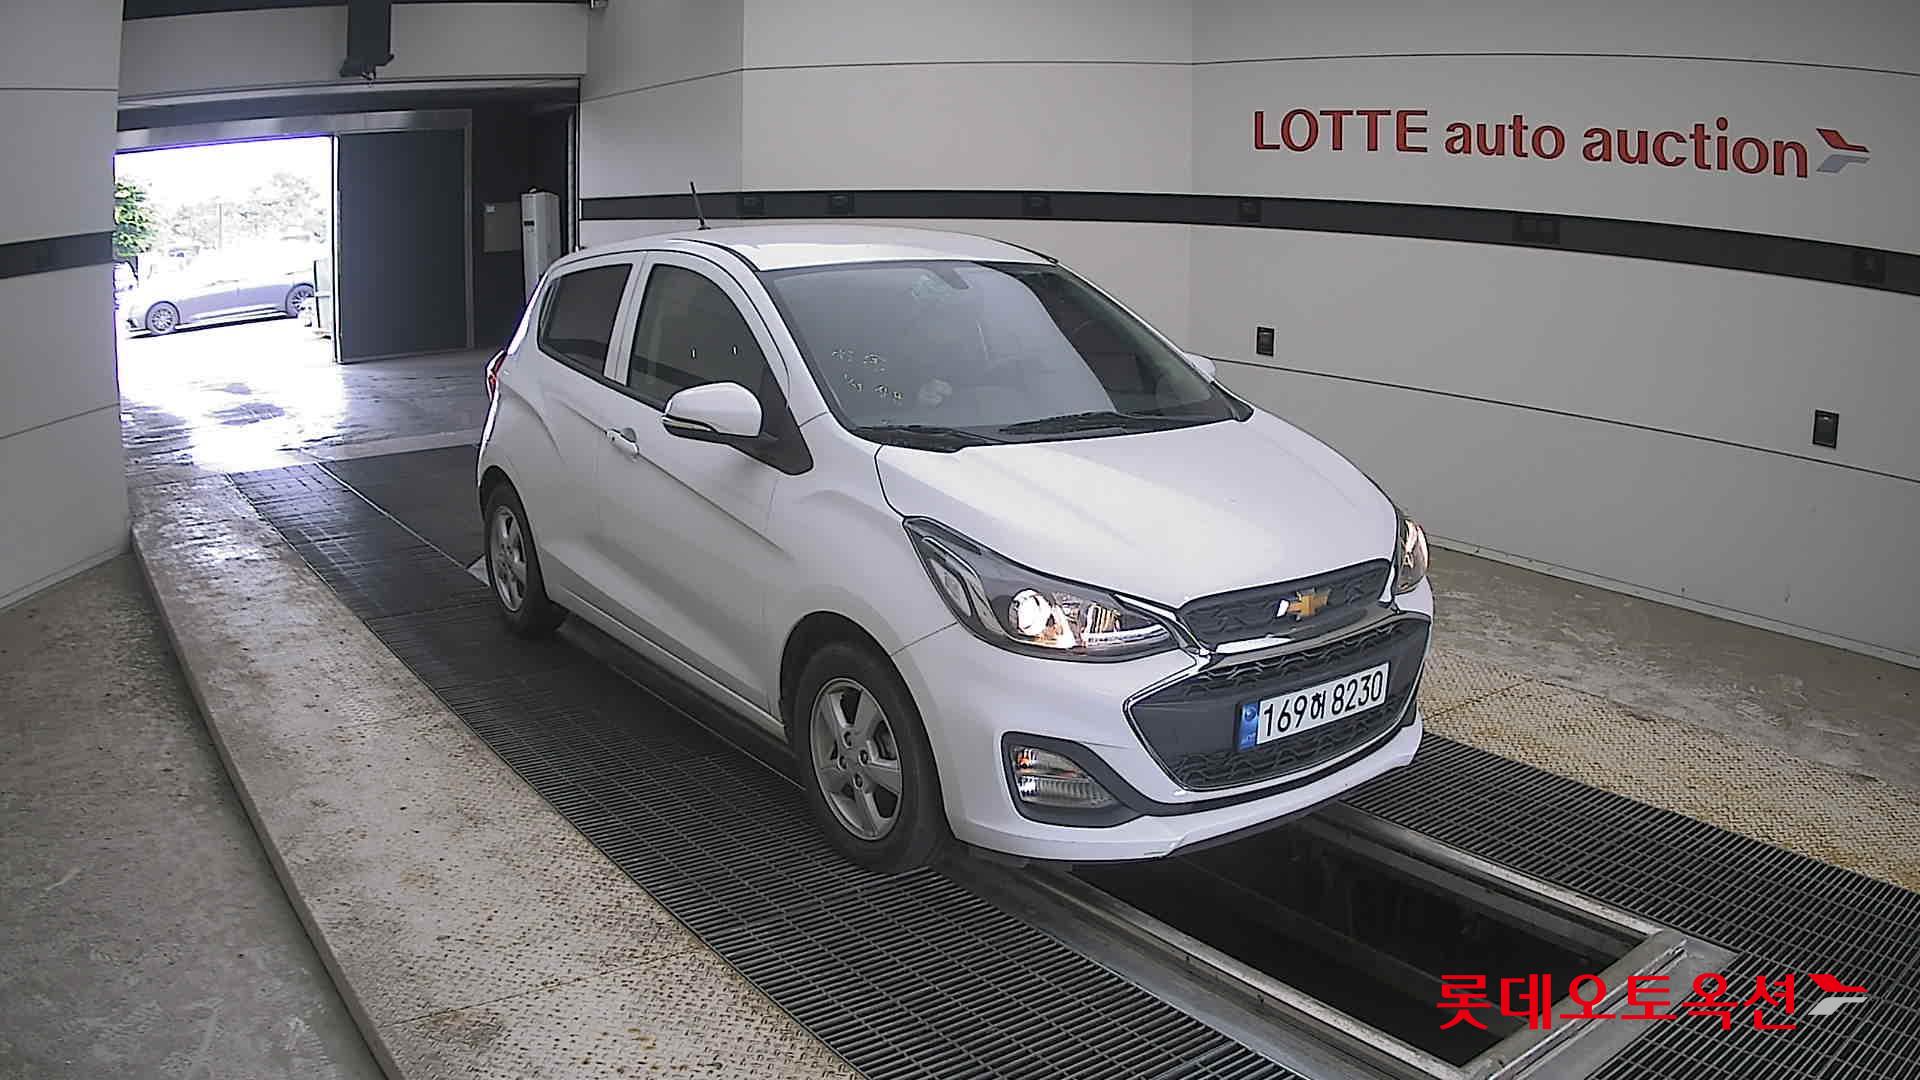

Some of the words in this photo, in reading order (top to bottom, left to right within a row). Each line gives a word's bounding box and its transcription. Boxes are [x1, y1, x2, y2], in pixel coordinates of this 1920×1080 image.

[1254, 110, 1428, 153] LOTTE
[1445, 115, 1566, 158] auto
[1583, 117, 1809, 178] auction
[1263, 691, 1327, 737] 169허
[1331, 670, 1384, 715] 8230
